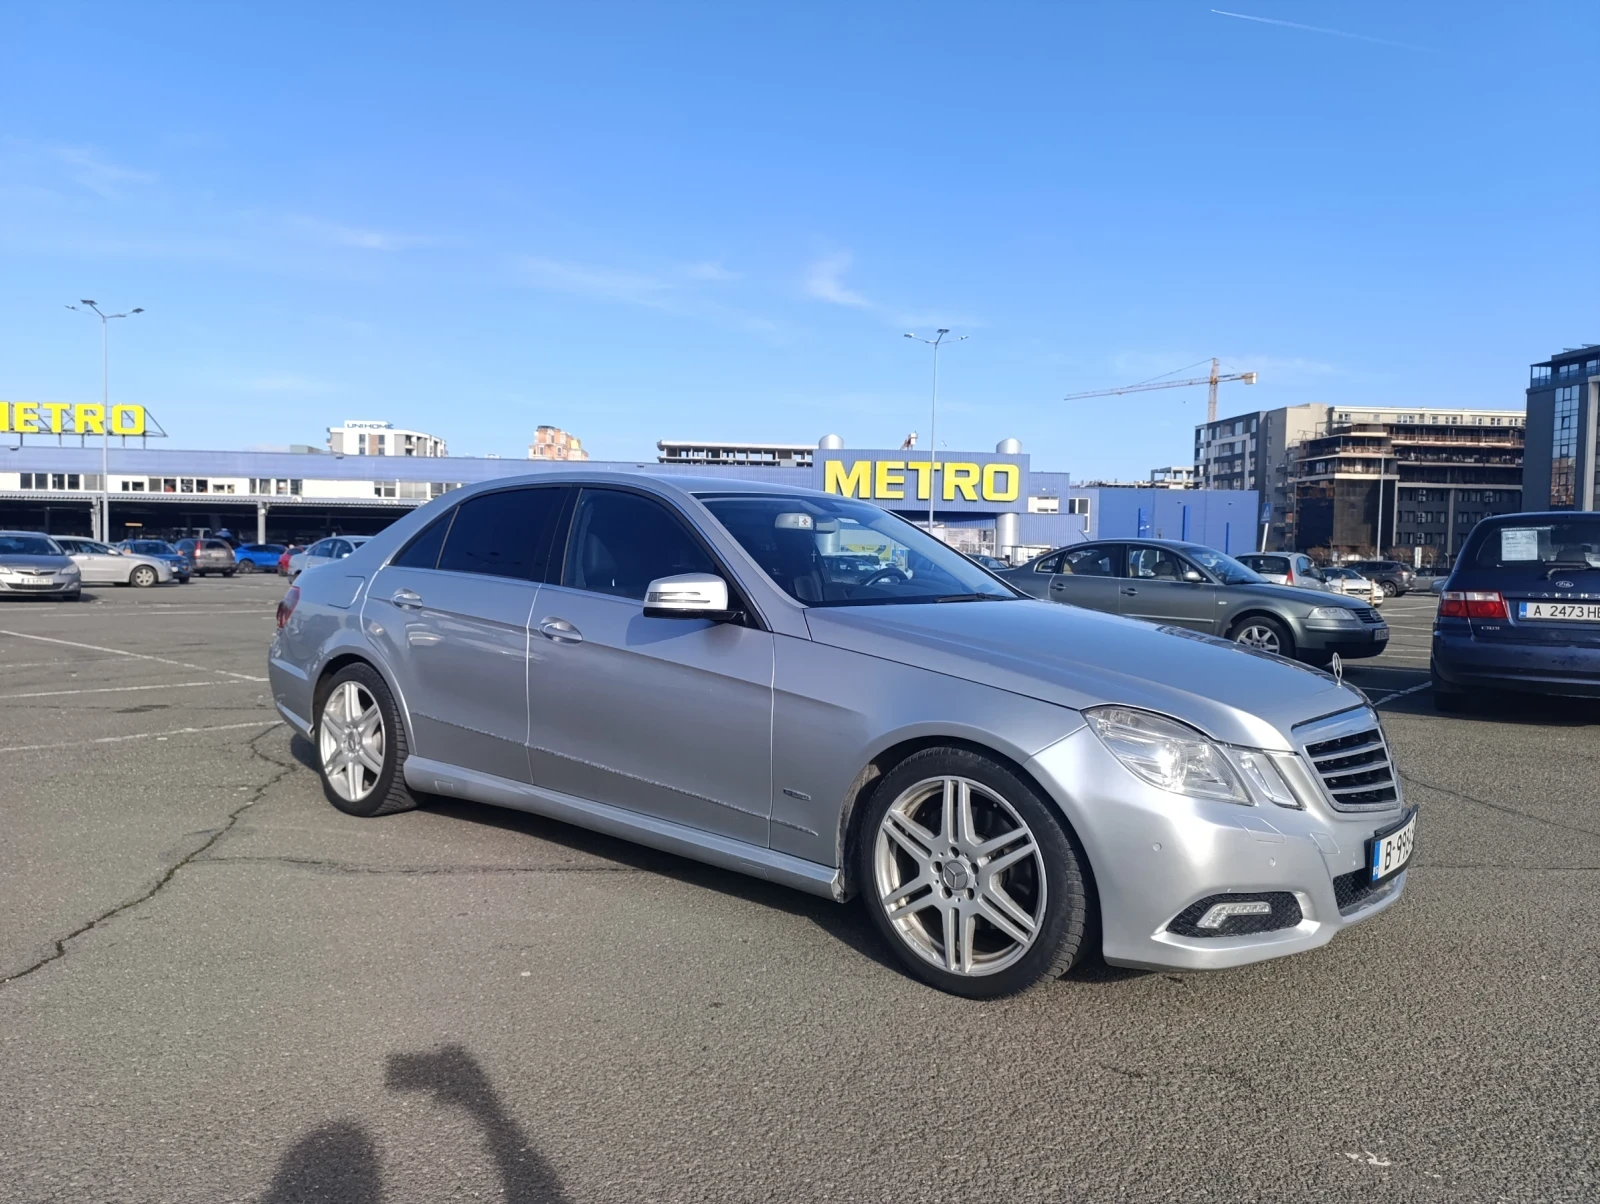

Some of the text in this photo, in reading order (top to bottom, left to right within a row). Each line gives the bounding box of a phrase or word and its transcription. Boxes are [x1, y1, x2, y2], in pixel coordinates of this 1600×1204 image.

[0, 402, 145, 435] ETRO
[824, 460, 1020, 502] METRO
[1533, 605, 1542, 616] A
[1549, 605, 1585, 618] 2473
